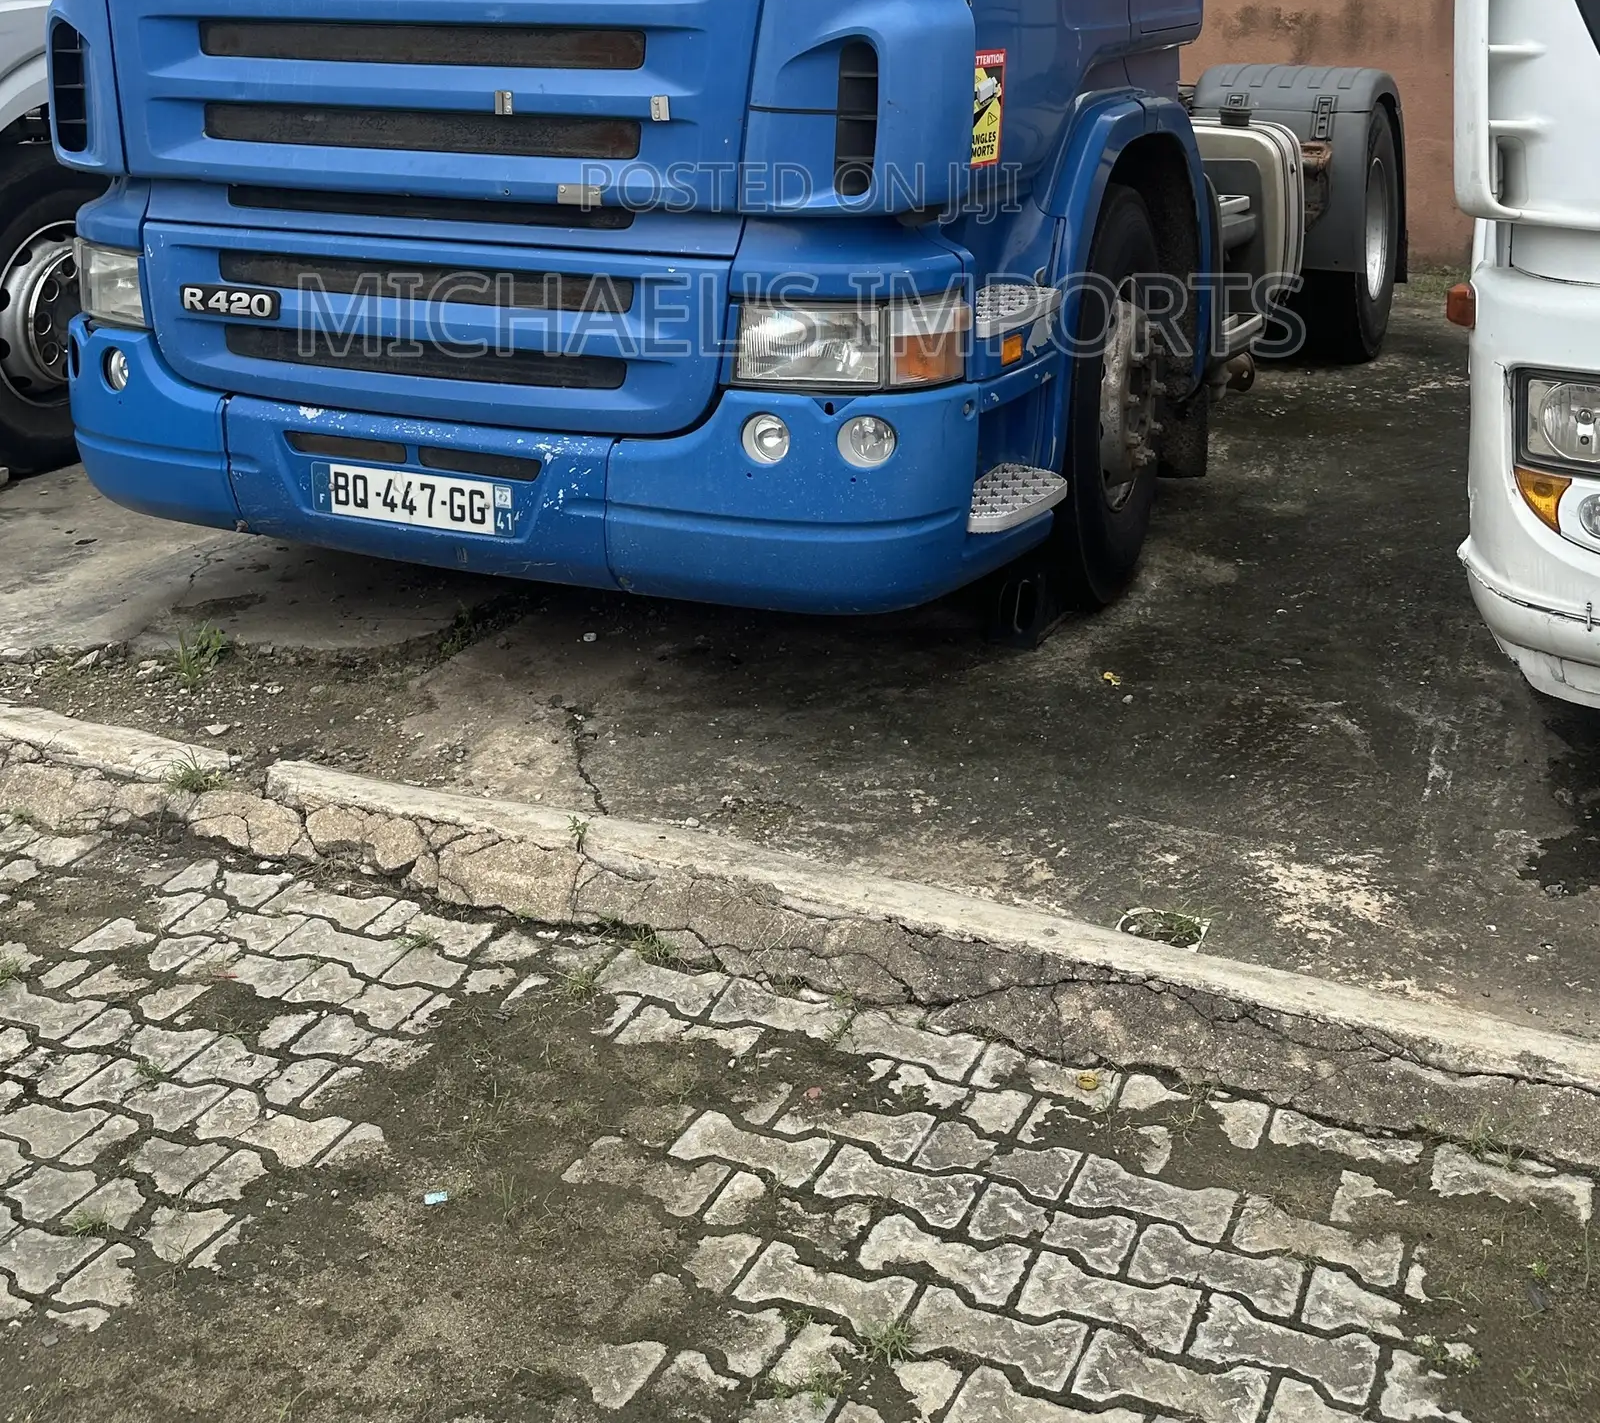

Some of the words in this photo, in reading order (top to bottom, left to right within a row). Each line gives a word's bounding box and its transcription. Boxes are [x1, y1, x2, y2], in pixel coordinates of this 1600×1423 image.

[975, 53, 1004, 66] TTENTION
[183, 287, 204, 311] R
[208, 290, 272, 317] 420
[319, 494, 326, 504] F
[333, 471, 487, 525] BQ-447-GG
[496, 511, 513, 531] 41
